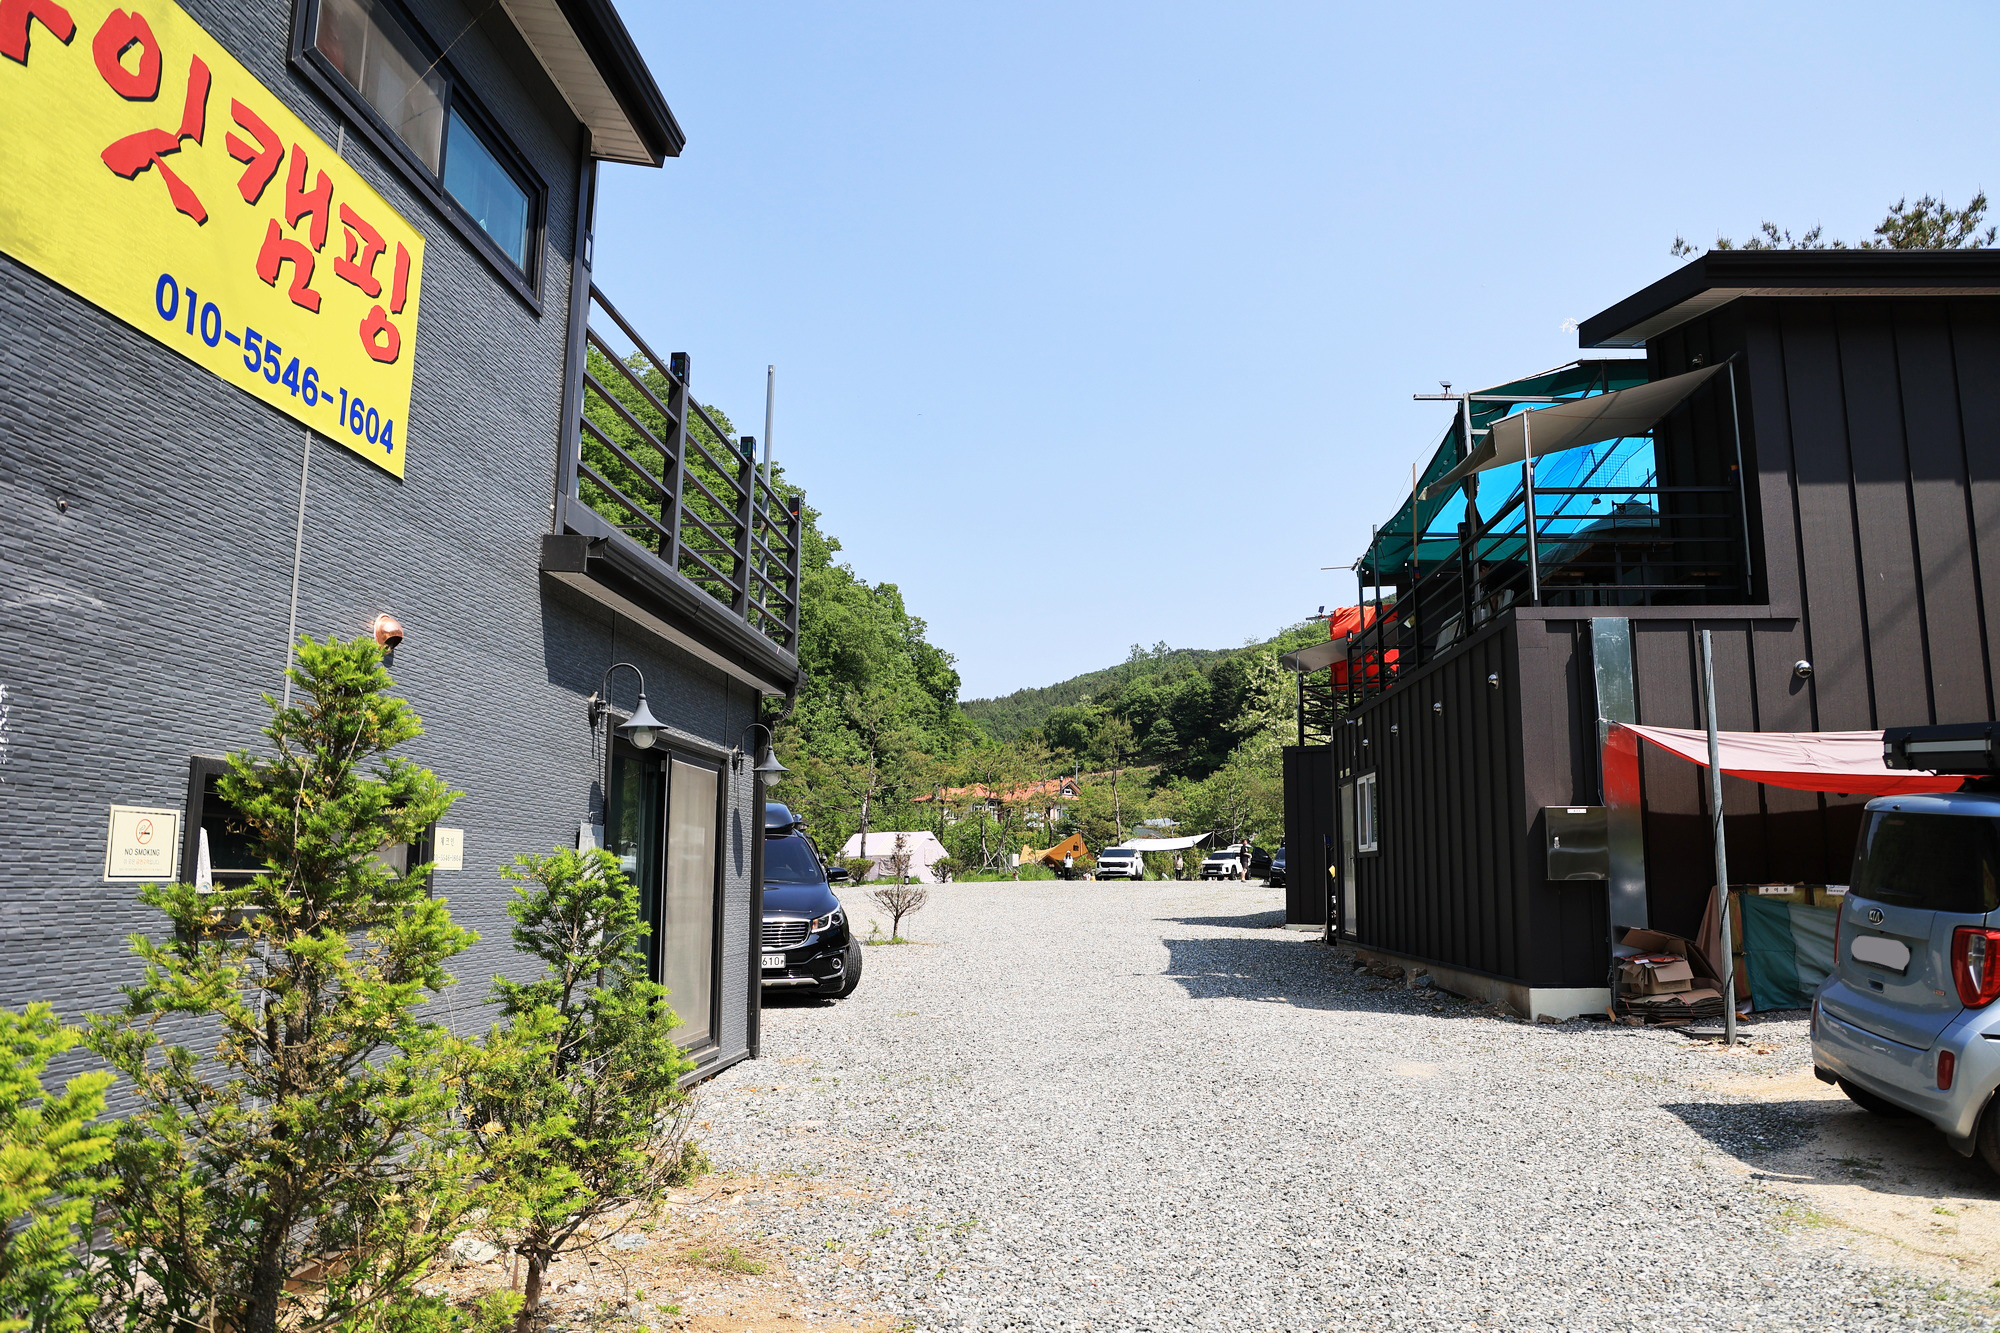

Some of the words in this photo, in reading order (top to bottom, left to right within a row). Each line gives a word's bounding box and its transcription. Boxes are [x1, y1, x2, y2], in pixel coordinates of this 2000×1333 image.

[155, 272, 394, 455] 010-5546-1604
[124, 848, 133, 856] NO
[134, 848, 160, 857] SMOKING
[1868, 910, 1881, 922] KIA
